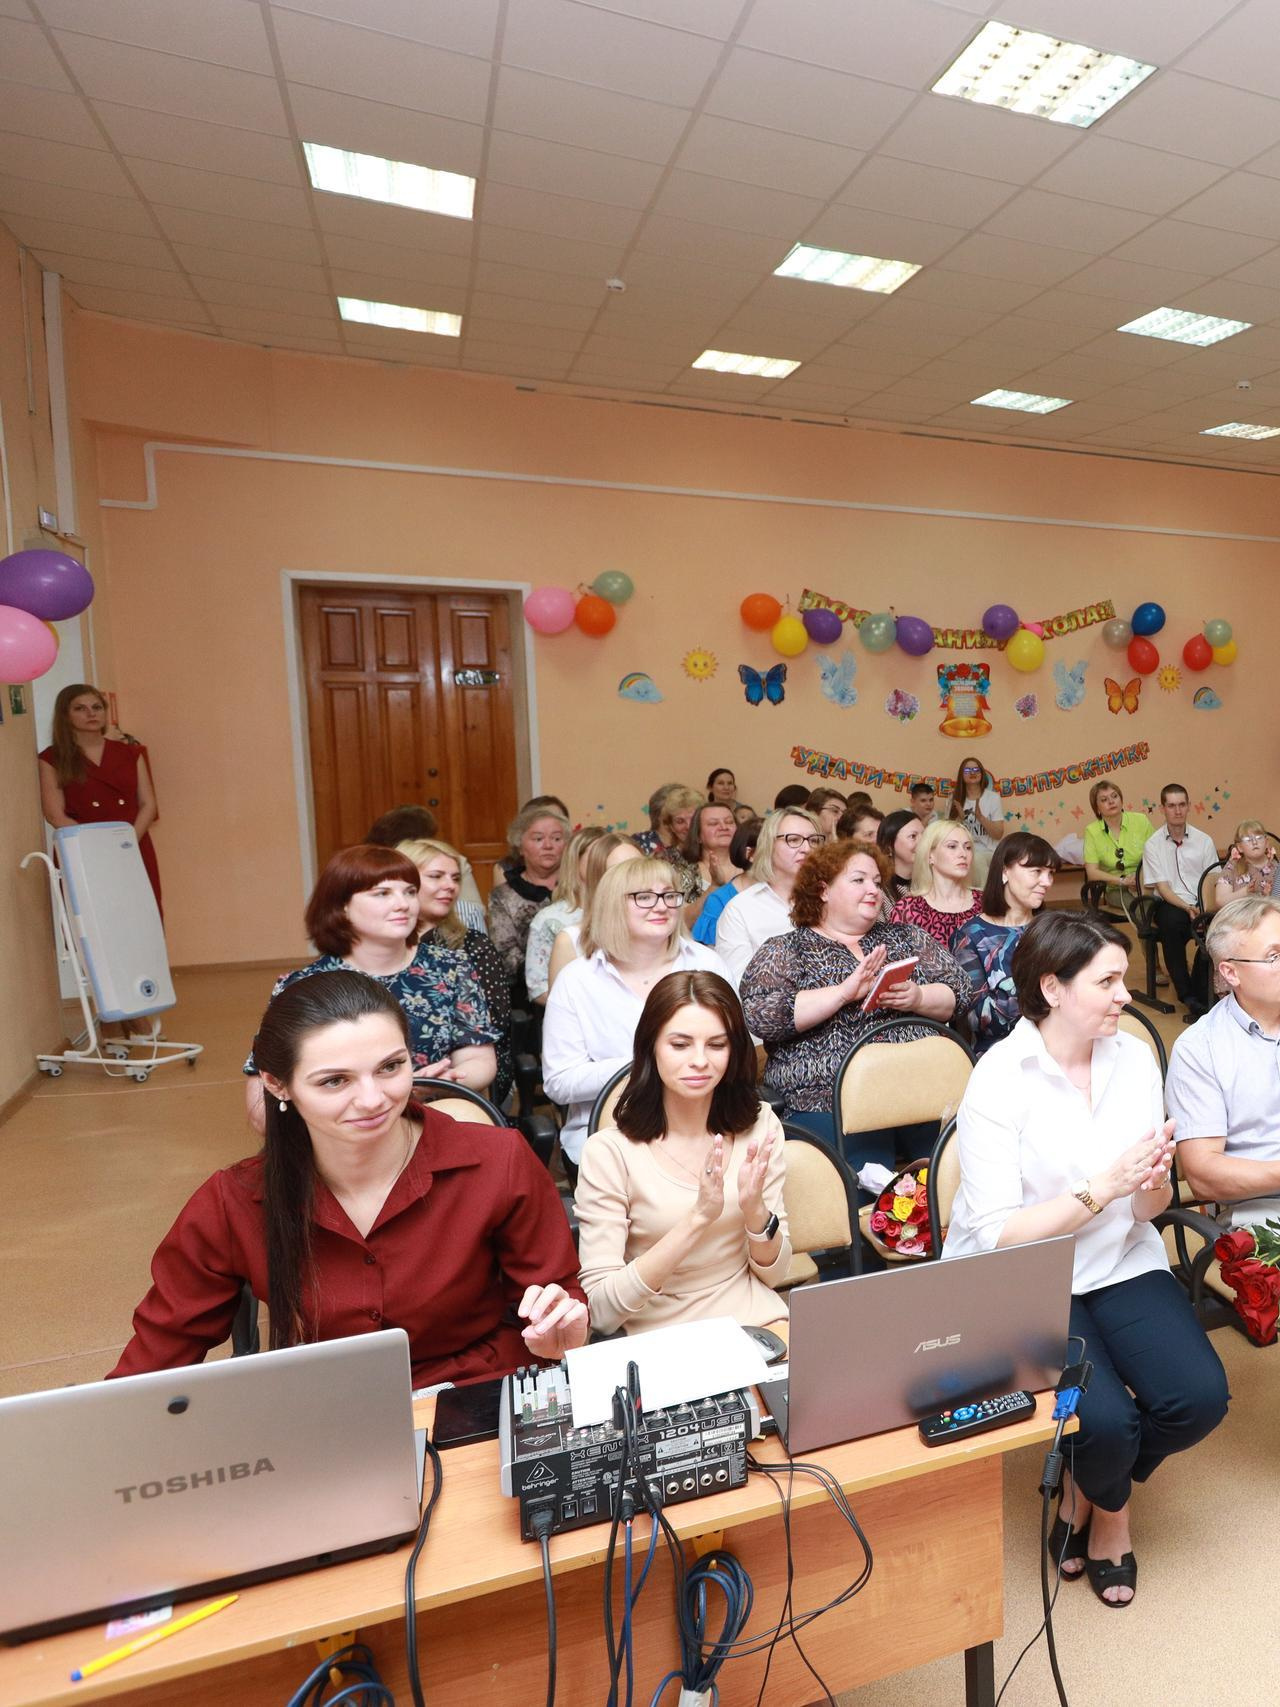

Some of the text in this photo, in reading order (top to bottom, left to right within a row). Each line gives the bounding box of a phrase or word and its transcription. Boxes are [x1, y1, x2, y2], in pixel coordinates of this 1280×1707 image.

[795, 747, 884, 788] УДАЧИ
[1000, 742, 1149, 798] ВЫПУСКНИК!
[913, 1333, 961, 1354] ASUS
[570, 1434, 650, 1460] XENX
[114, 1457, 275, 1504] TOSHIBA
[521, 1478, 559, 1491] behringer
